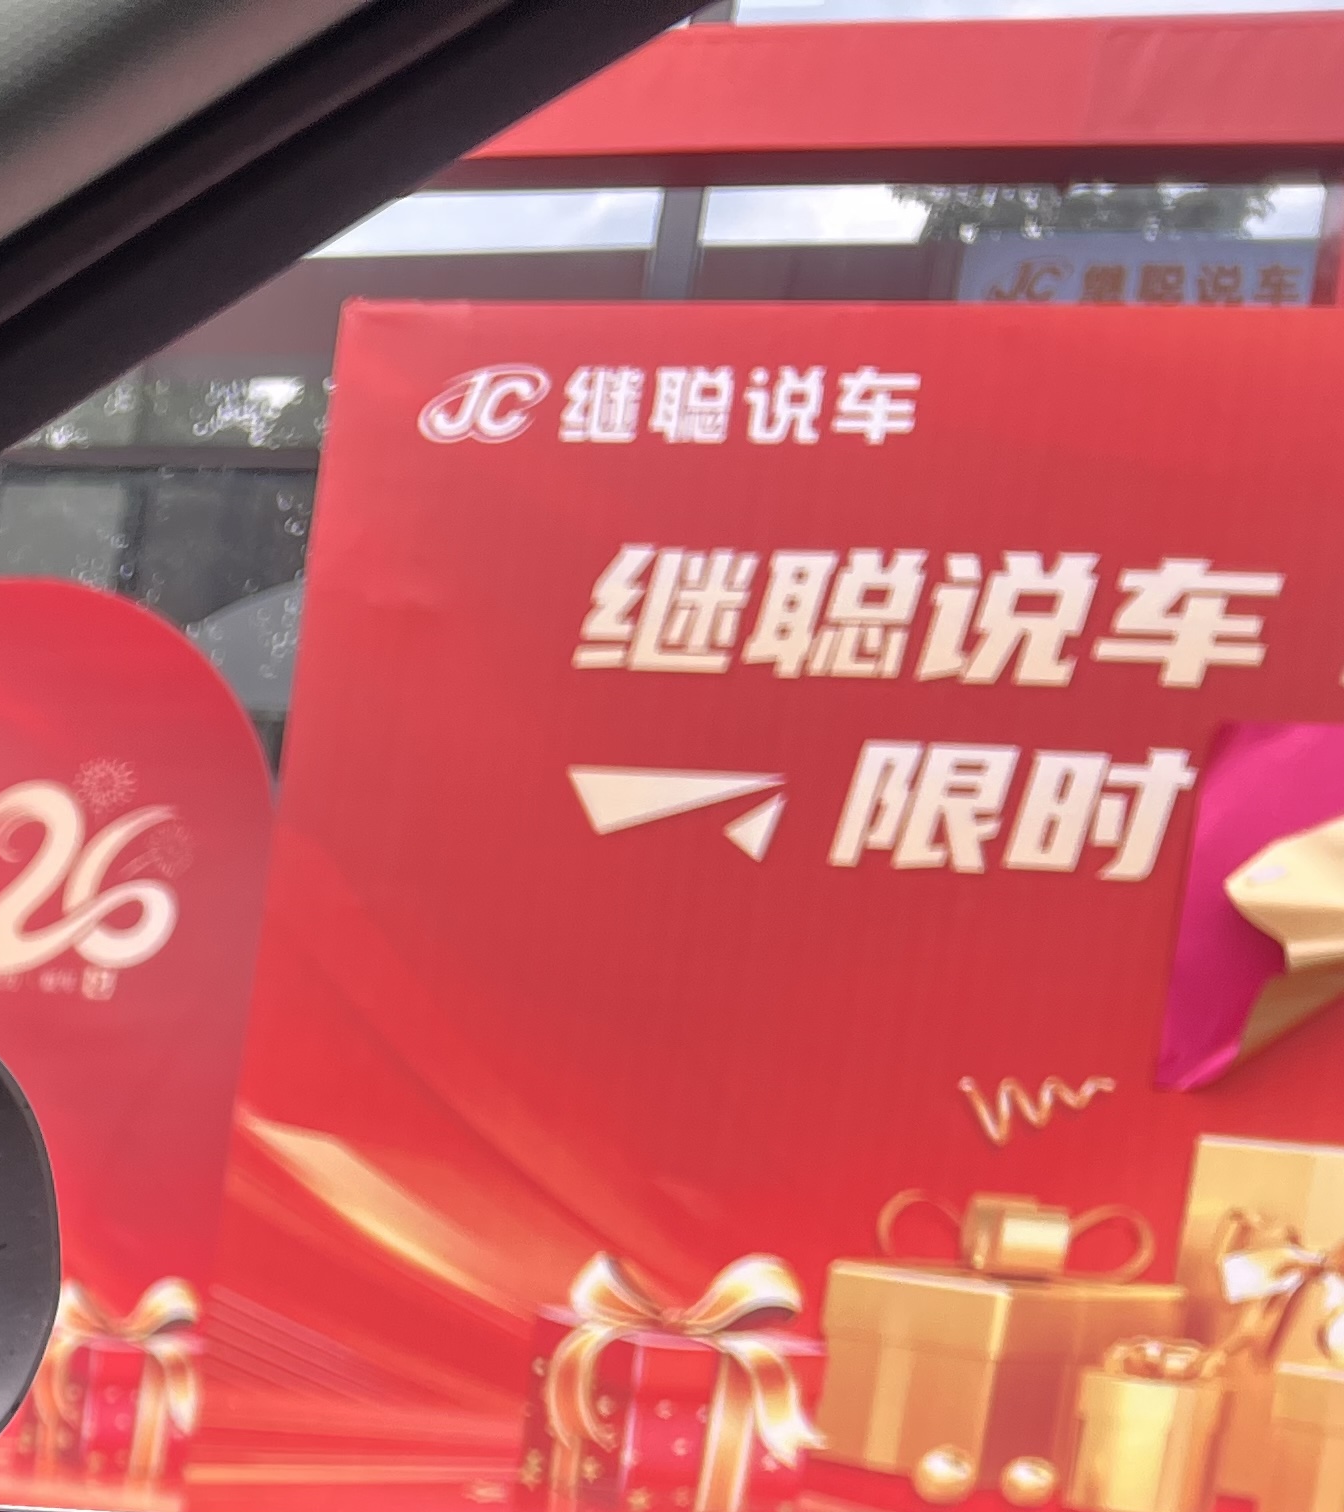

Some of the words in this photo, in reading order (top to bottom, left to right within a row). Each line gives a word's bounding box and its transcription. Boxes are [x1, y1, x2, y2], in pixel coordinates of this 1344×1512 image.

[421, 366, 548, 442] JC
[559, 365, 921, 444] 继聪说车
[572, 542, 1286, 688] 继聪说车
[828, 738, 1198, 882] 限时
